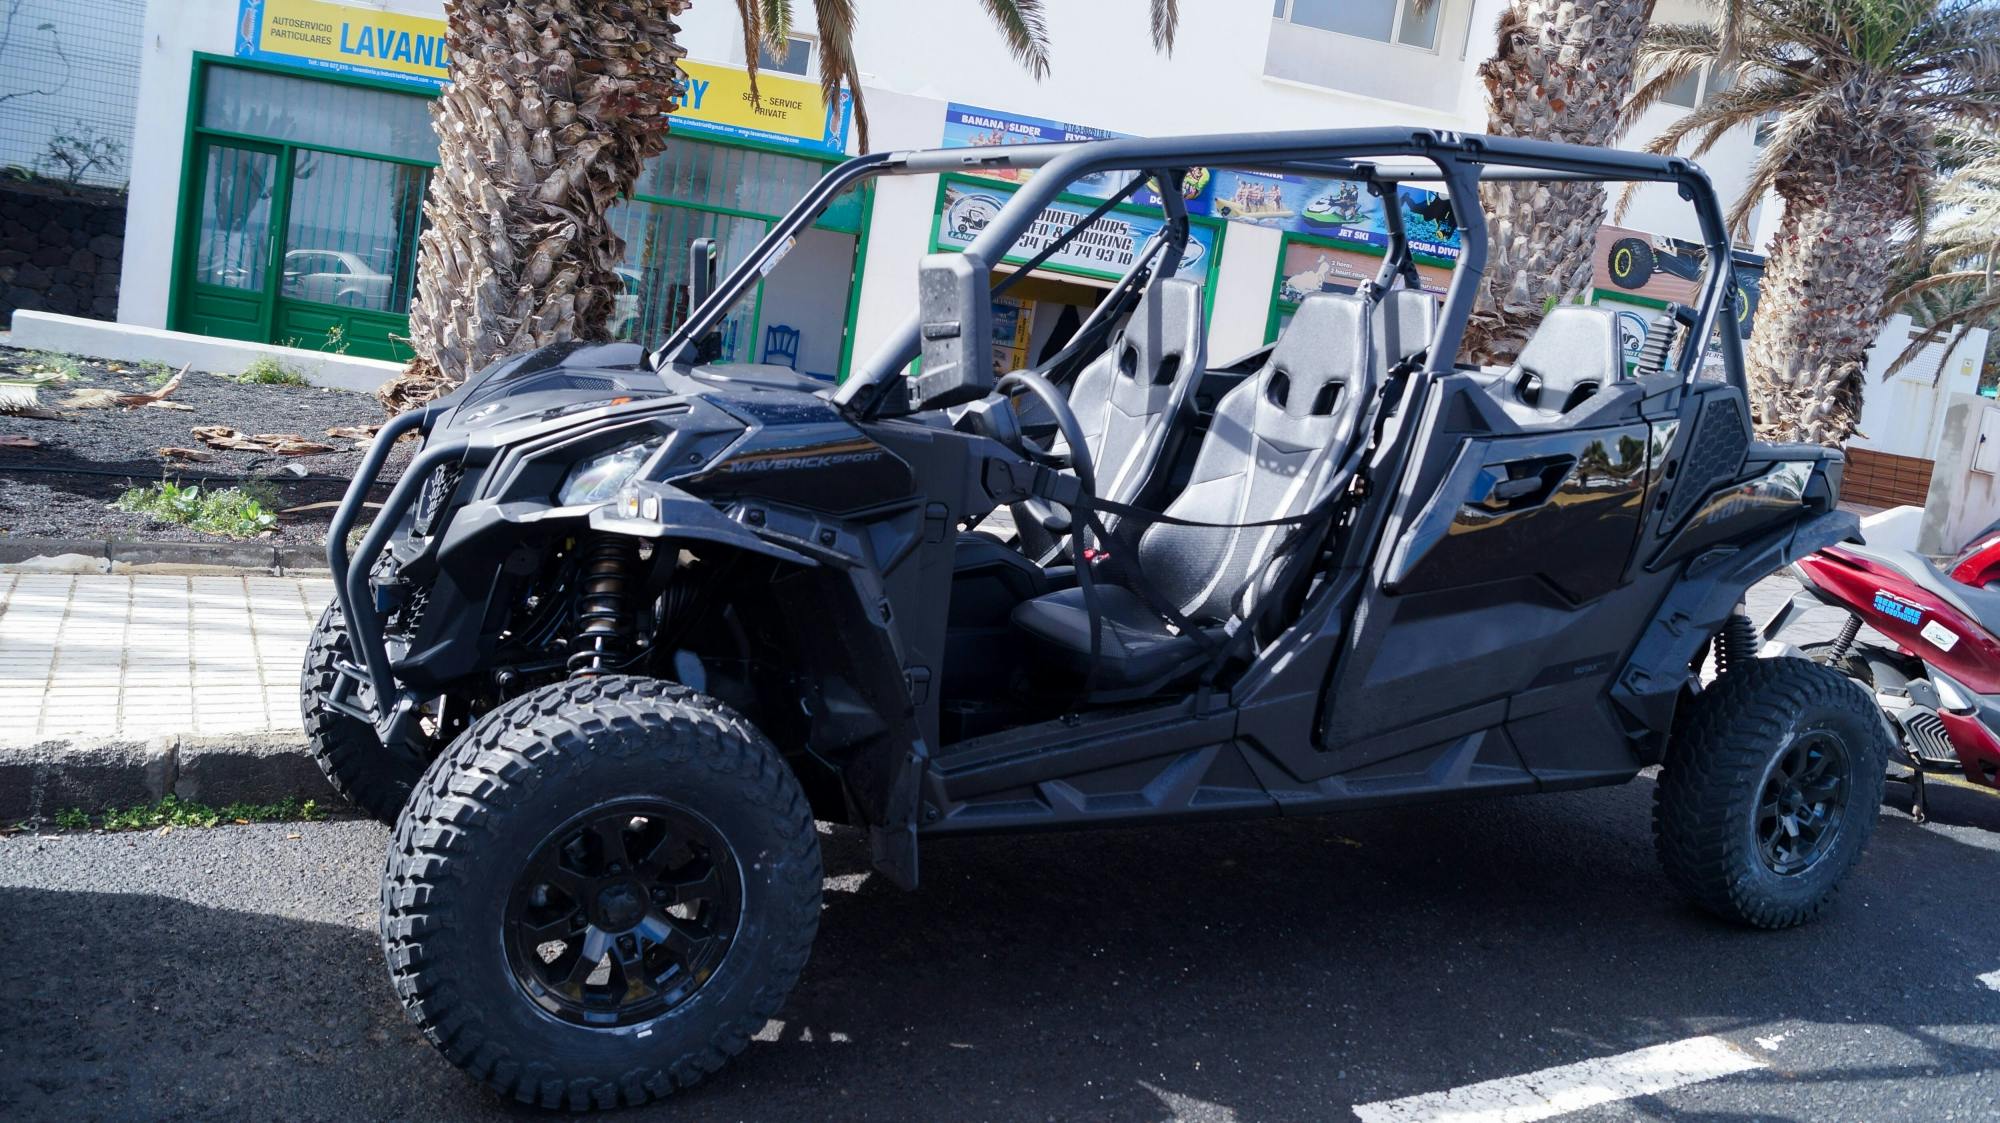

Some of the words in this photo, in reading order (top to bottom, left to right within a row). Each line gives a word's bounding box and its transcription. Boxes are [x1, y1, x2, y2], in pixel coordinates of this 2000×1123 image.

[272, 16, 333, 33] AUTOSERVICIO
[270, 28, 332, 46] PARTICULARES
[769, 97, 803, 110] SERVICE
[755, 106, 788, 120] PRIVATE
[961, 114, 1004, 130] BANANA
[1009, 123, 1041, 137] SLIDER
[1090, 218, 1128, 235] OURS
[1338, 228, 1353, 238] JET
[1354, 231, 1369, 241] SKI
[1075, 243, 1093, 258] 74
[1096, 247, 1115, 262] 93
[1118, 252, 1134, 265] 18
[1408, 240, 1436, 253] SCUBA
[1437, 245, 1461, 257] DIVI
[729, 456, 832, 473] MAVERICK
[832, 452, 882, 464] SPORT
